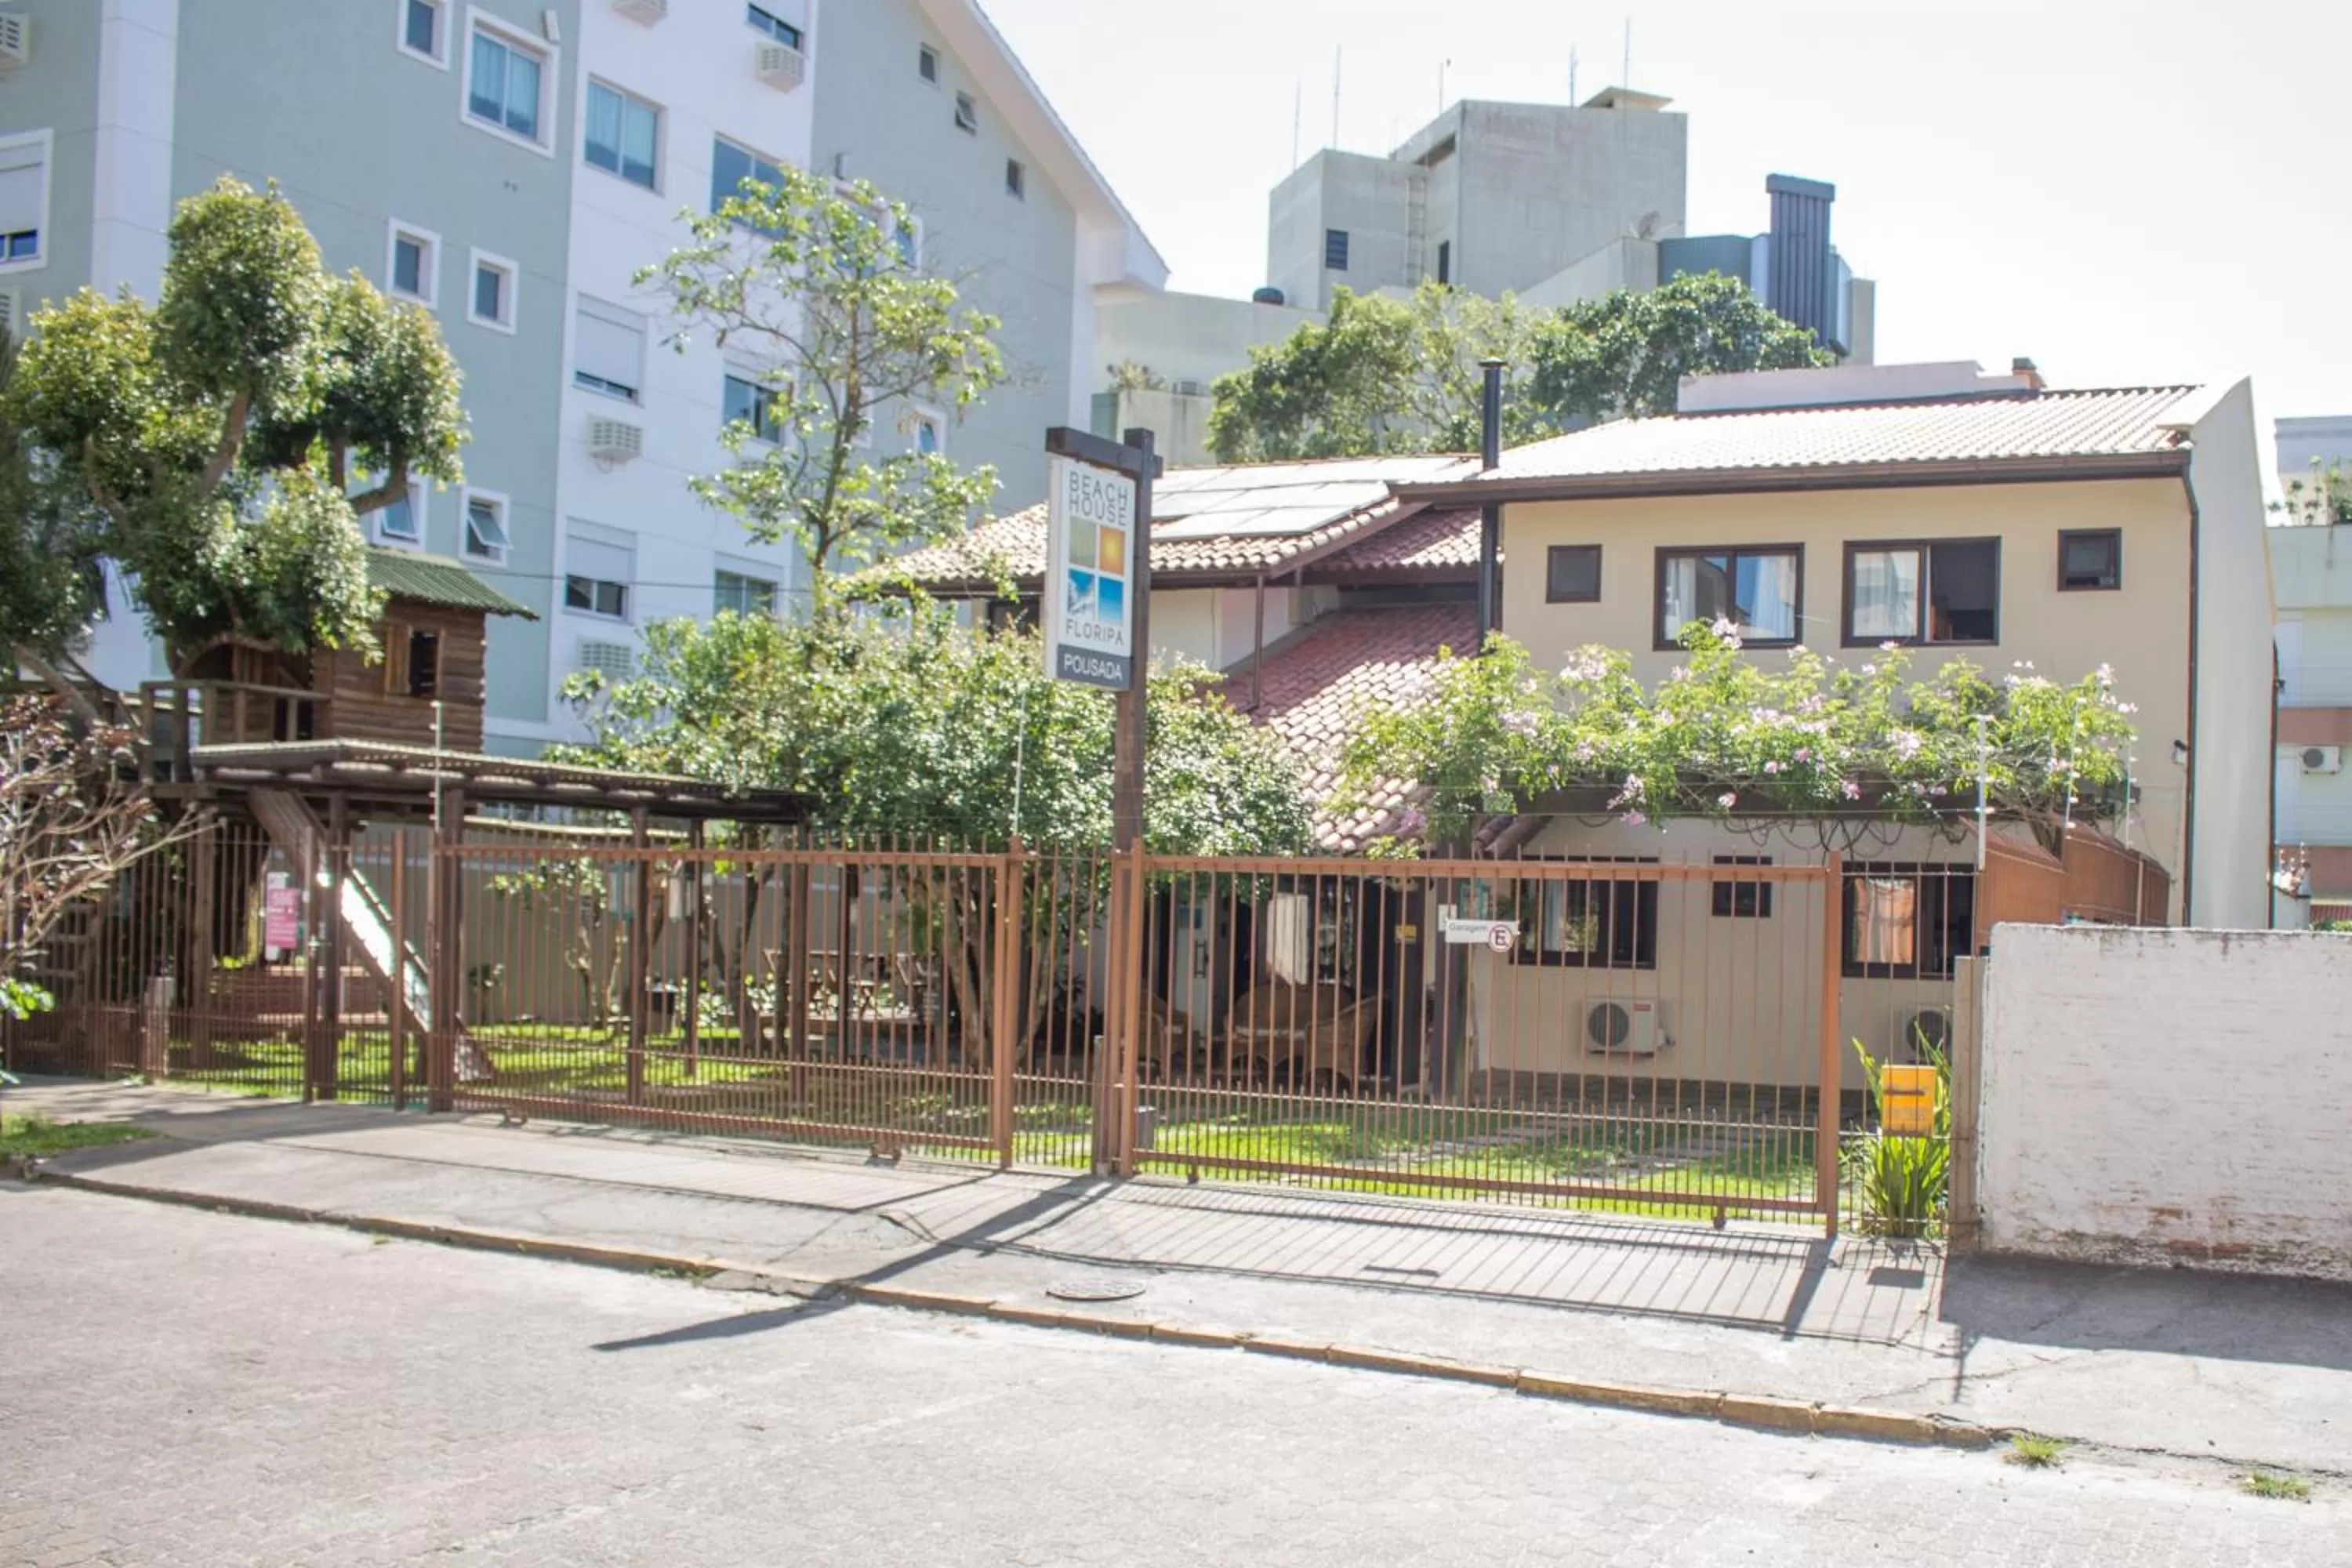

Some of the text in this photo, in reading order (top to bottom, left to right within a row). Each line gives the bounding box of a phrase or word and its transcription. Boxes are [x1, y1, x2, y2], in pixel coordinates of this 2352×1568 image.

[1069, 471, 1128, 504] BEACH
[1069, 496, 1127, 527] HOUSE
[1065, 619, 1124, 647] FLORIPA
[1064, 653, 1123, 681] POUSADA
